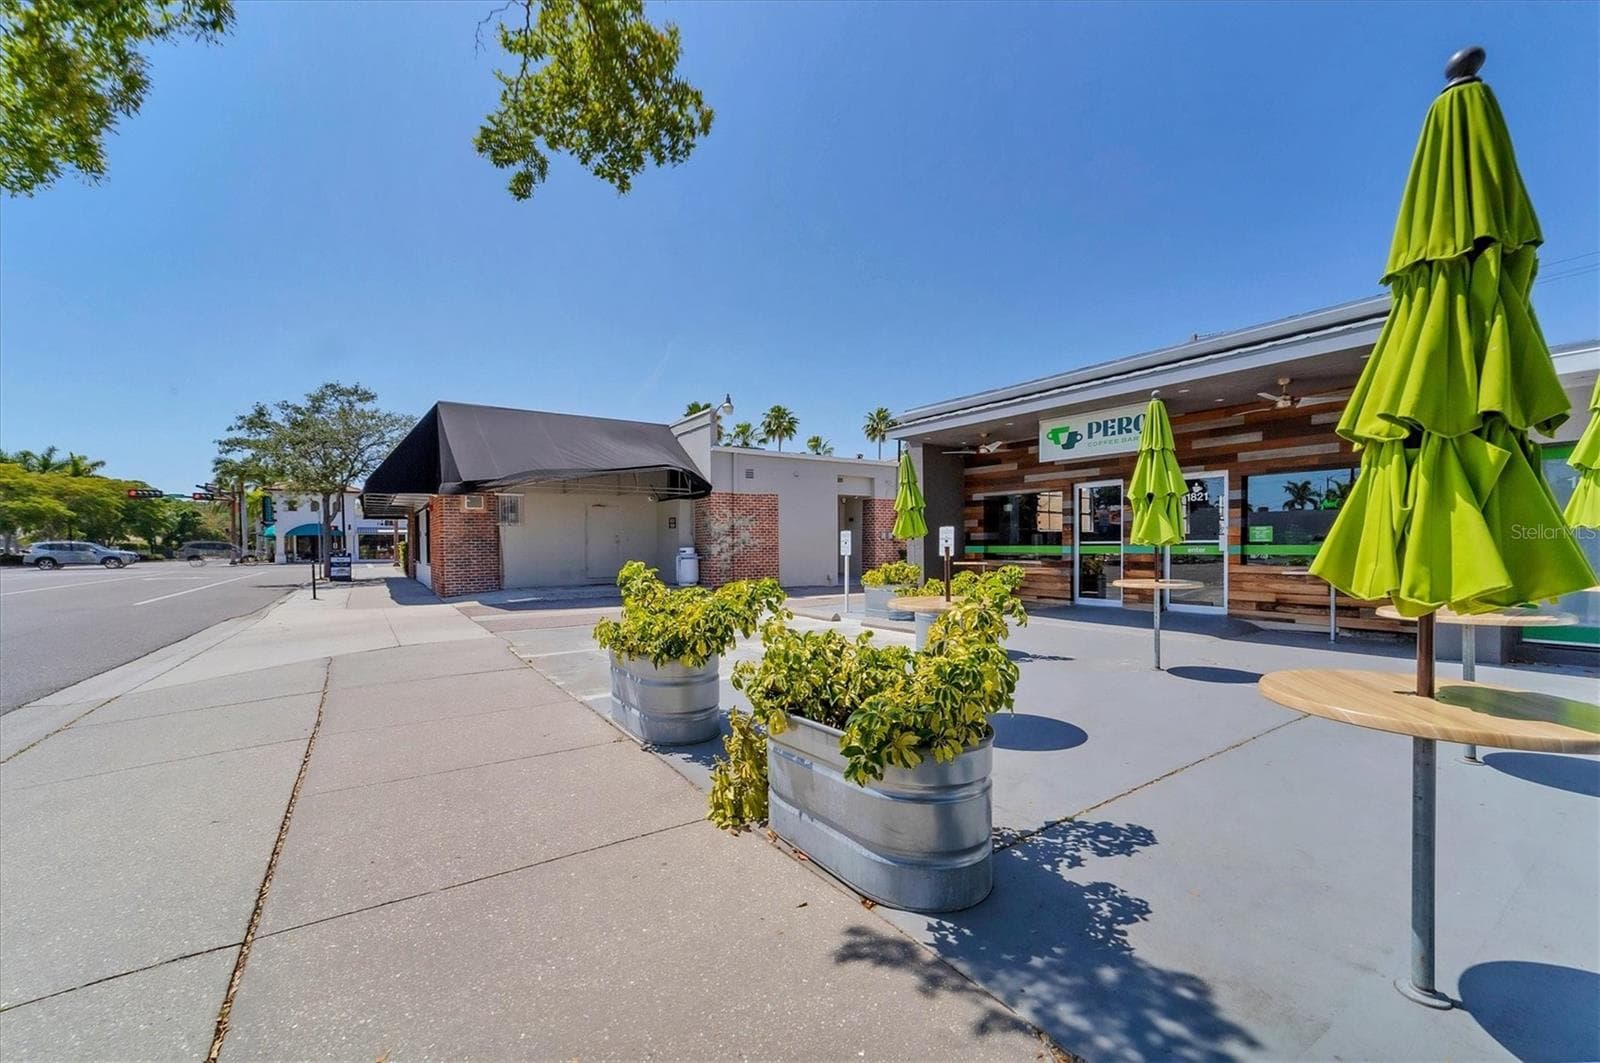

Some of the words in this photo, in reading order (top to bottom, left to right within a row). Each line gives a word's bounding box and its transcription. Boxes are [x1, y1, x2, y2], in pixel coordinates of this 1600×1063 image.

[1087, 439, 1120, 448] COFFEE
[1186, 492, 1208, 502] 1821
[1187, 545, 1207, 553] enter
